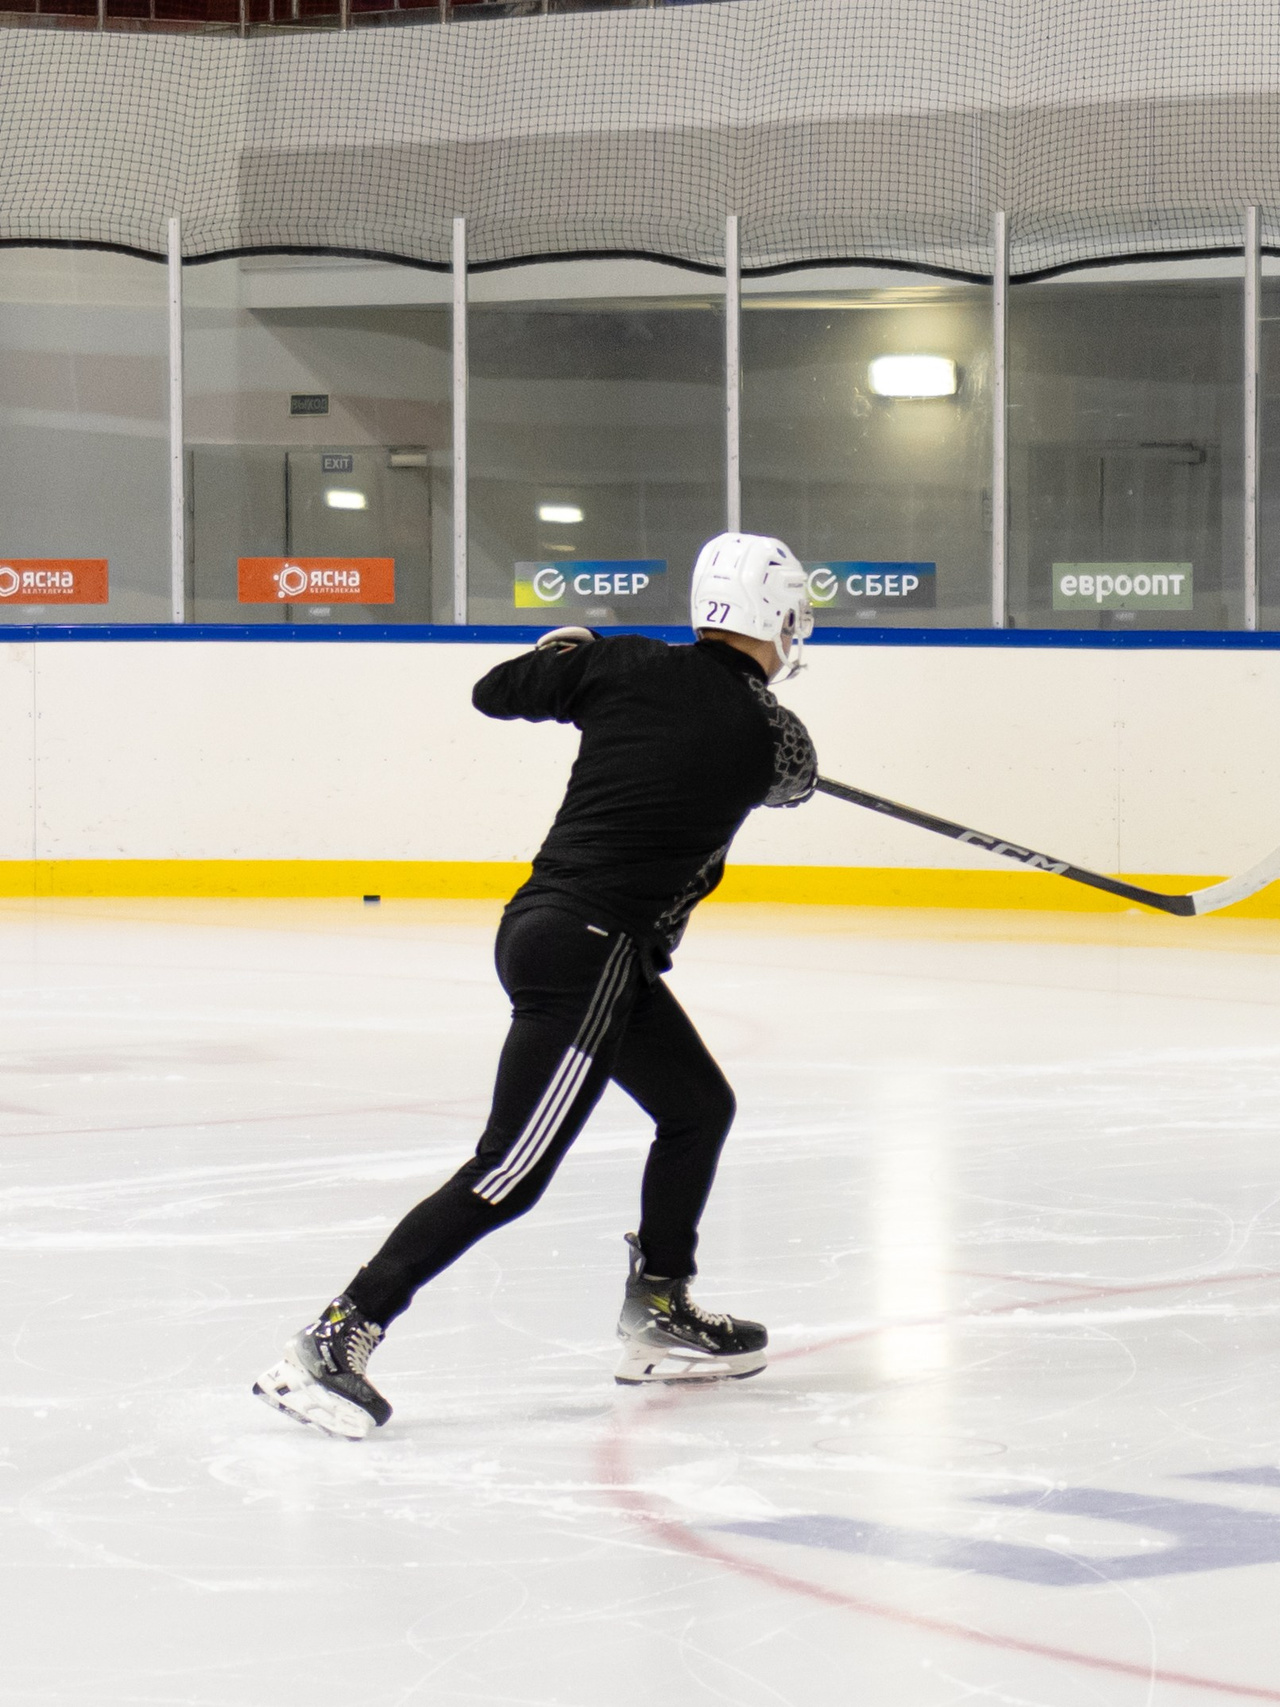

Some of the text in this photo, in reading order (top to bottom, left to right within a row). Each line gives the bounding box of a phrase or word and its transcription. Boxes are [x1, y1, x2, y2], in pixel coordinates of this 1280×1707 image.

[324, 458, 349, 469] EXIT
[573, 573, 650, 596] СБЕР
[846, 573, 919, 597] СБЕР
[1060, 574, 1185, 603] евроопт
[706, 601, 731, 624] 27
[957, 830, 1070, 875] CCM
